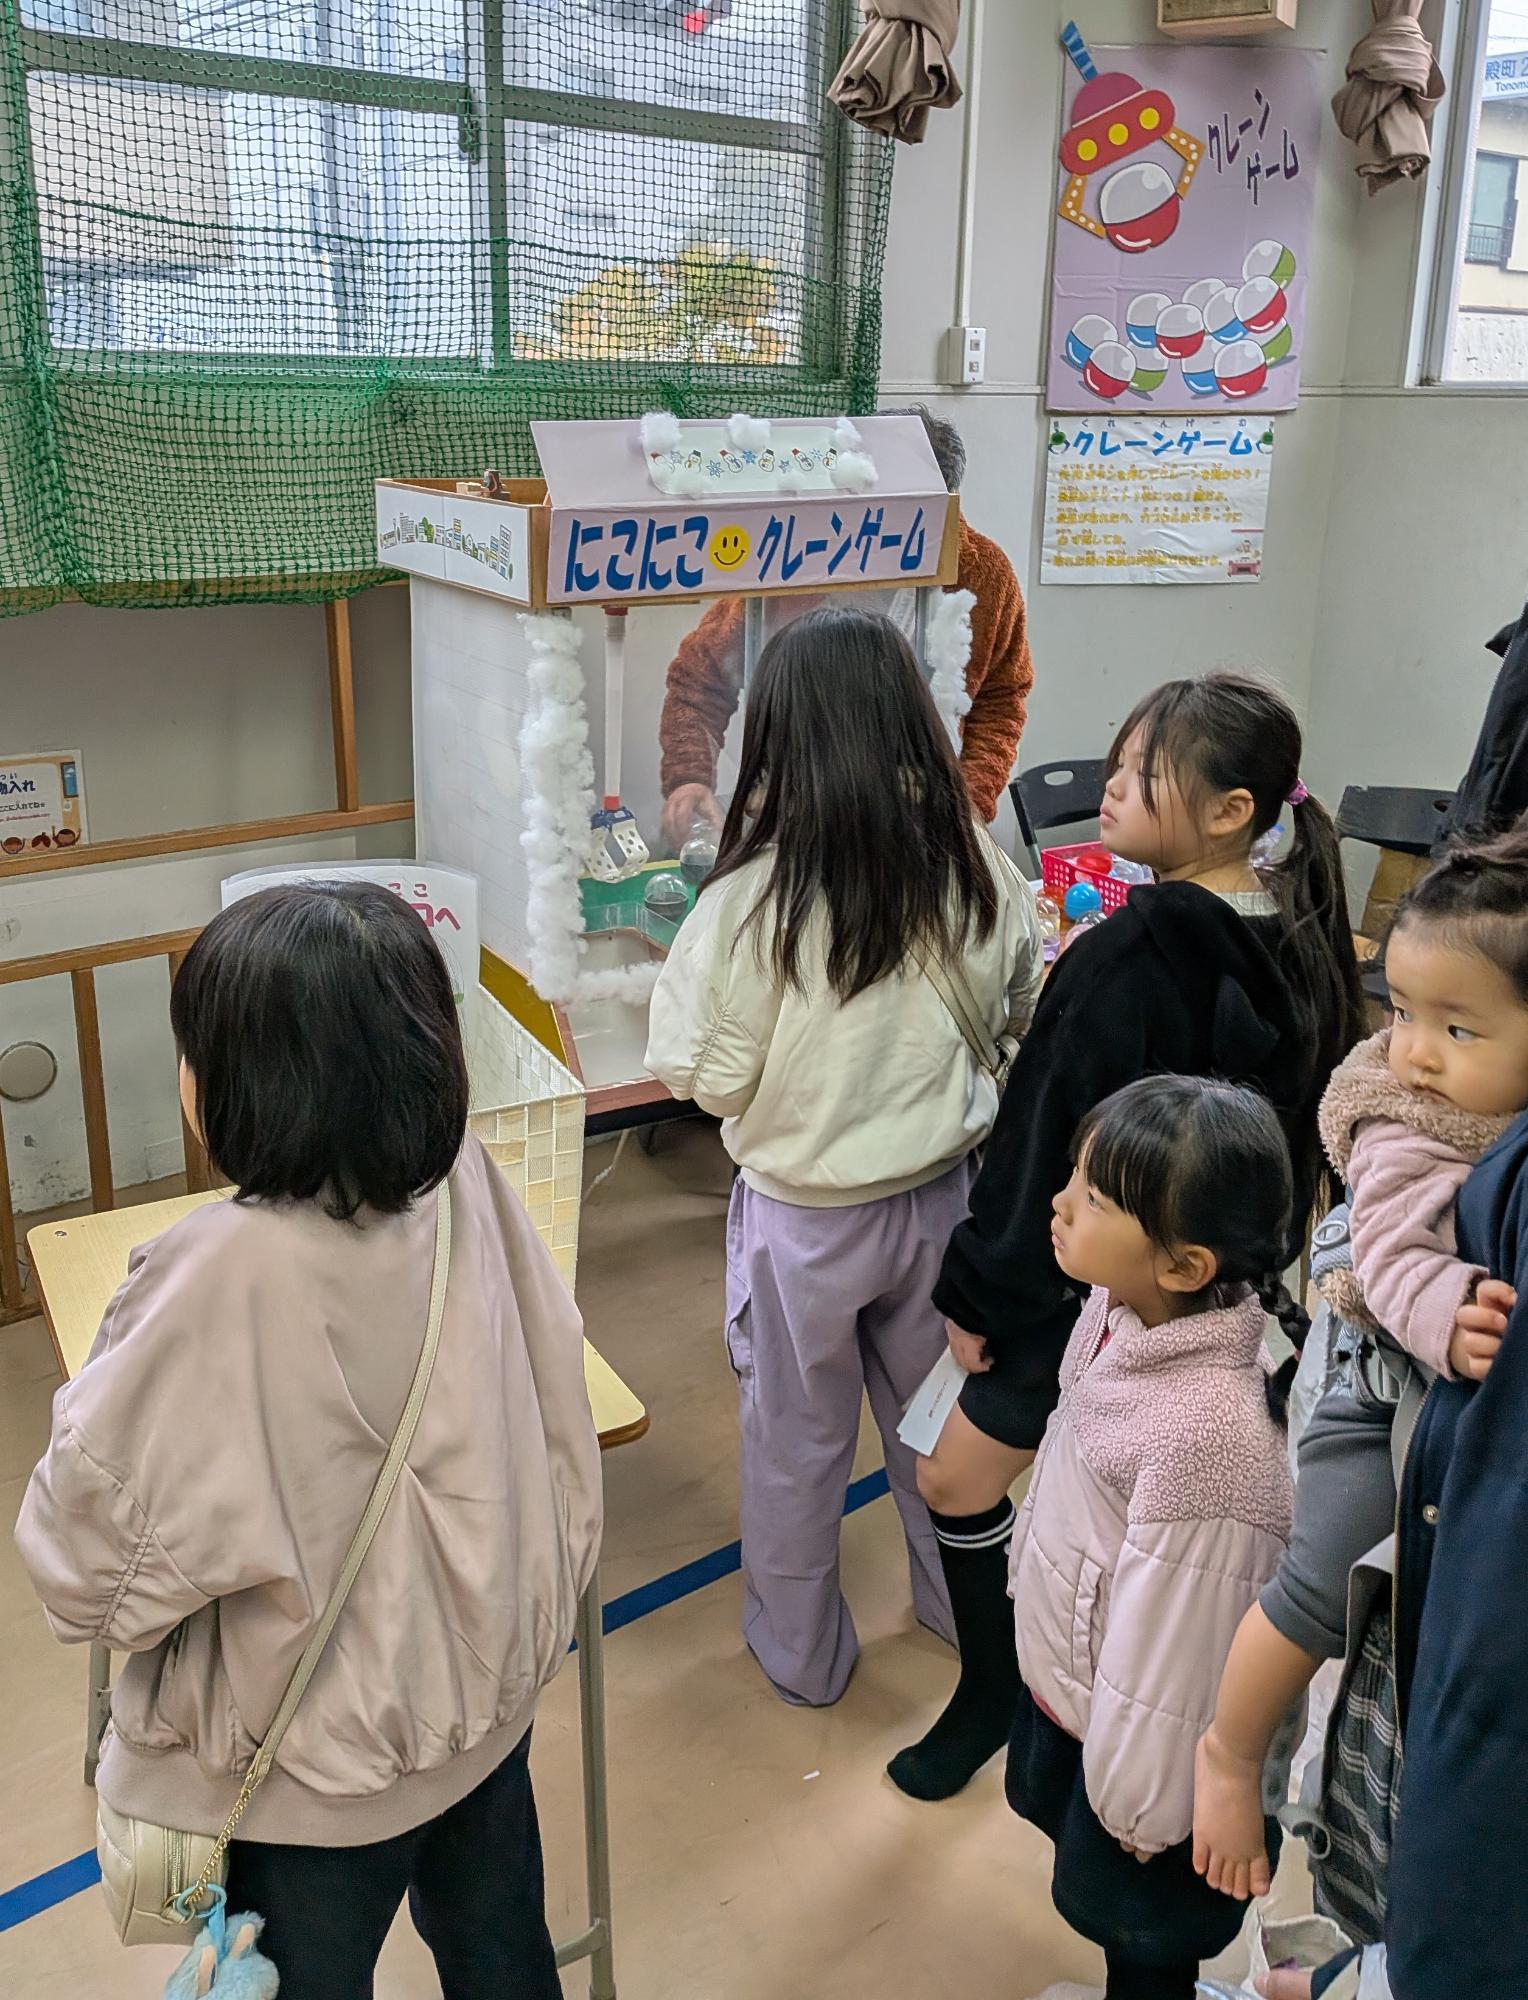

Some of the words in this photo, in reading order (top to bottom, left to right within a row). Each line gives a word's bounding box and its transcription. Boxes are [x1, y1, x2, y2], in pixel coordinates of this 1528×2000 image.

[1208, 88, 1270, 173] クレーン
[1247, 128, 1299, 206] ゲーム
[1073, 430, 1253, 456] クレーンゲーム
[565, 515, 709, 593] にこにこ
[756, 506, 926, 583] クレーンゲーム
